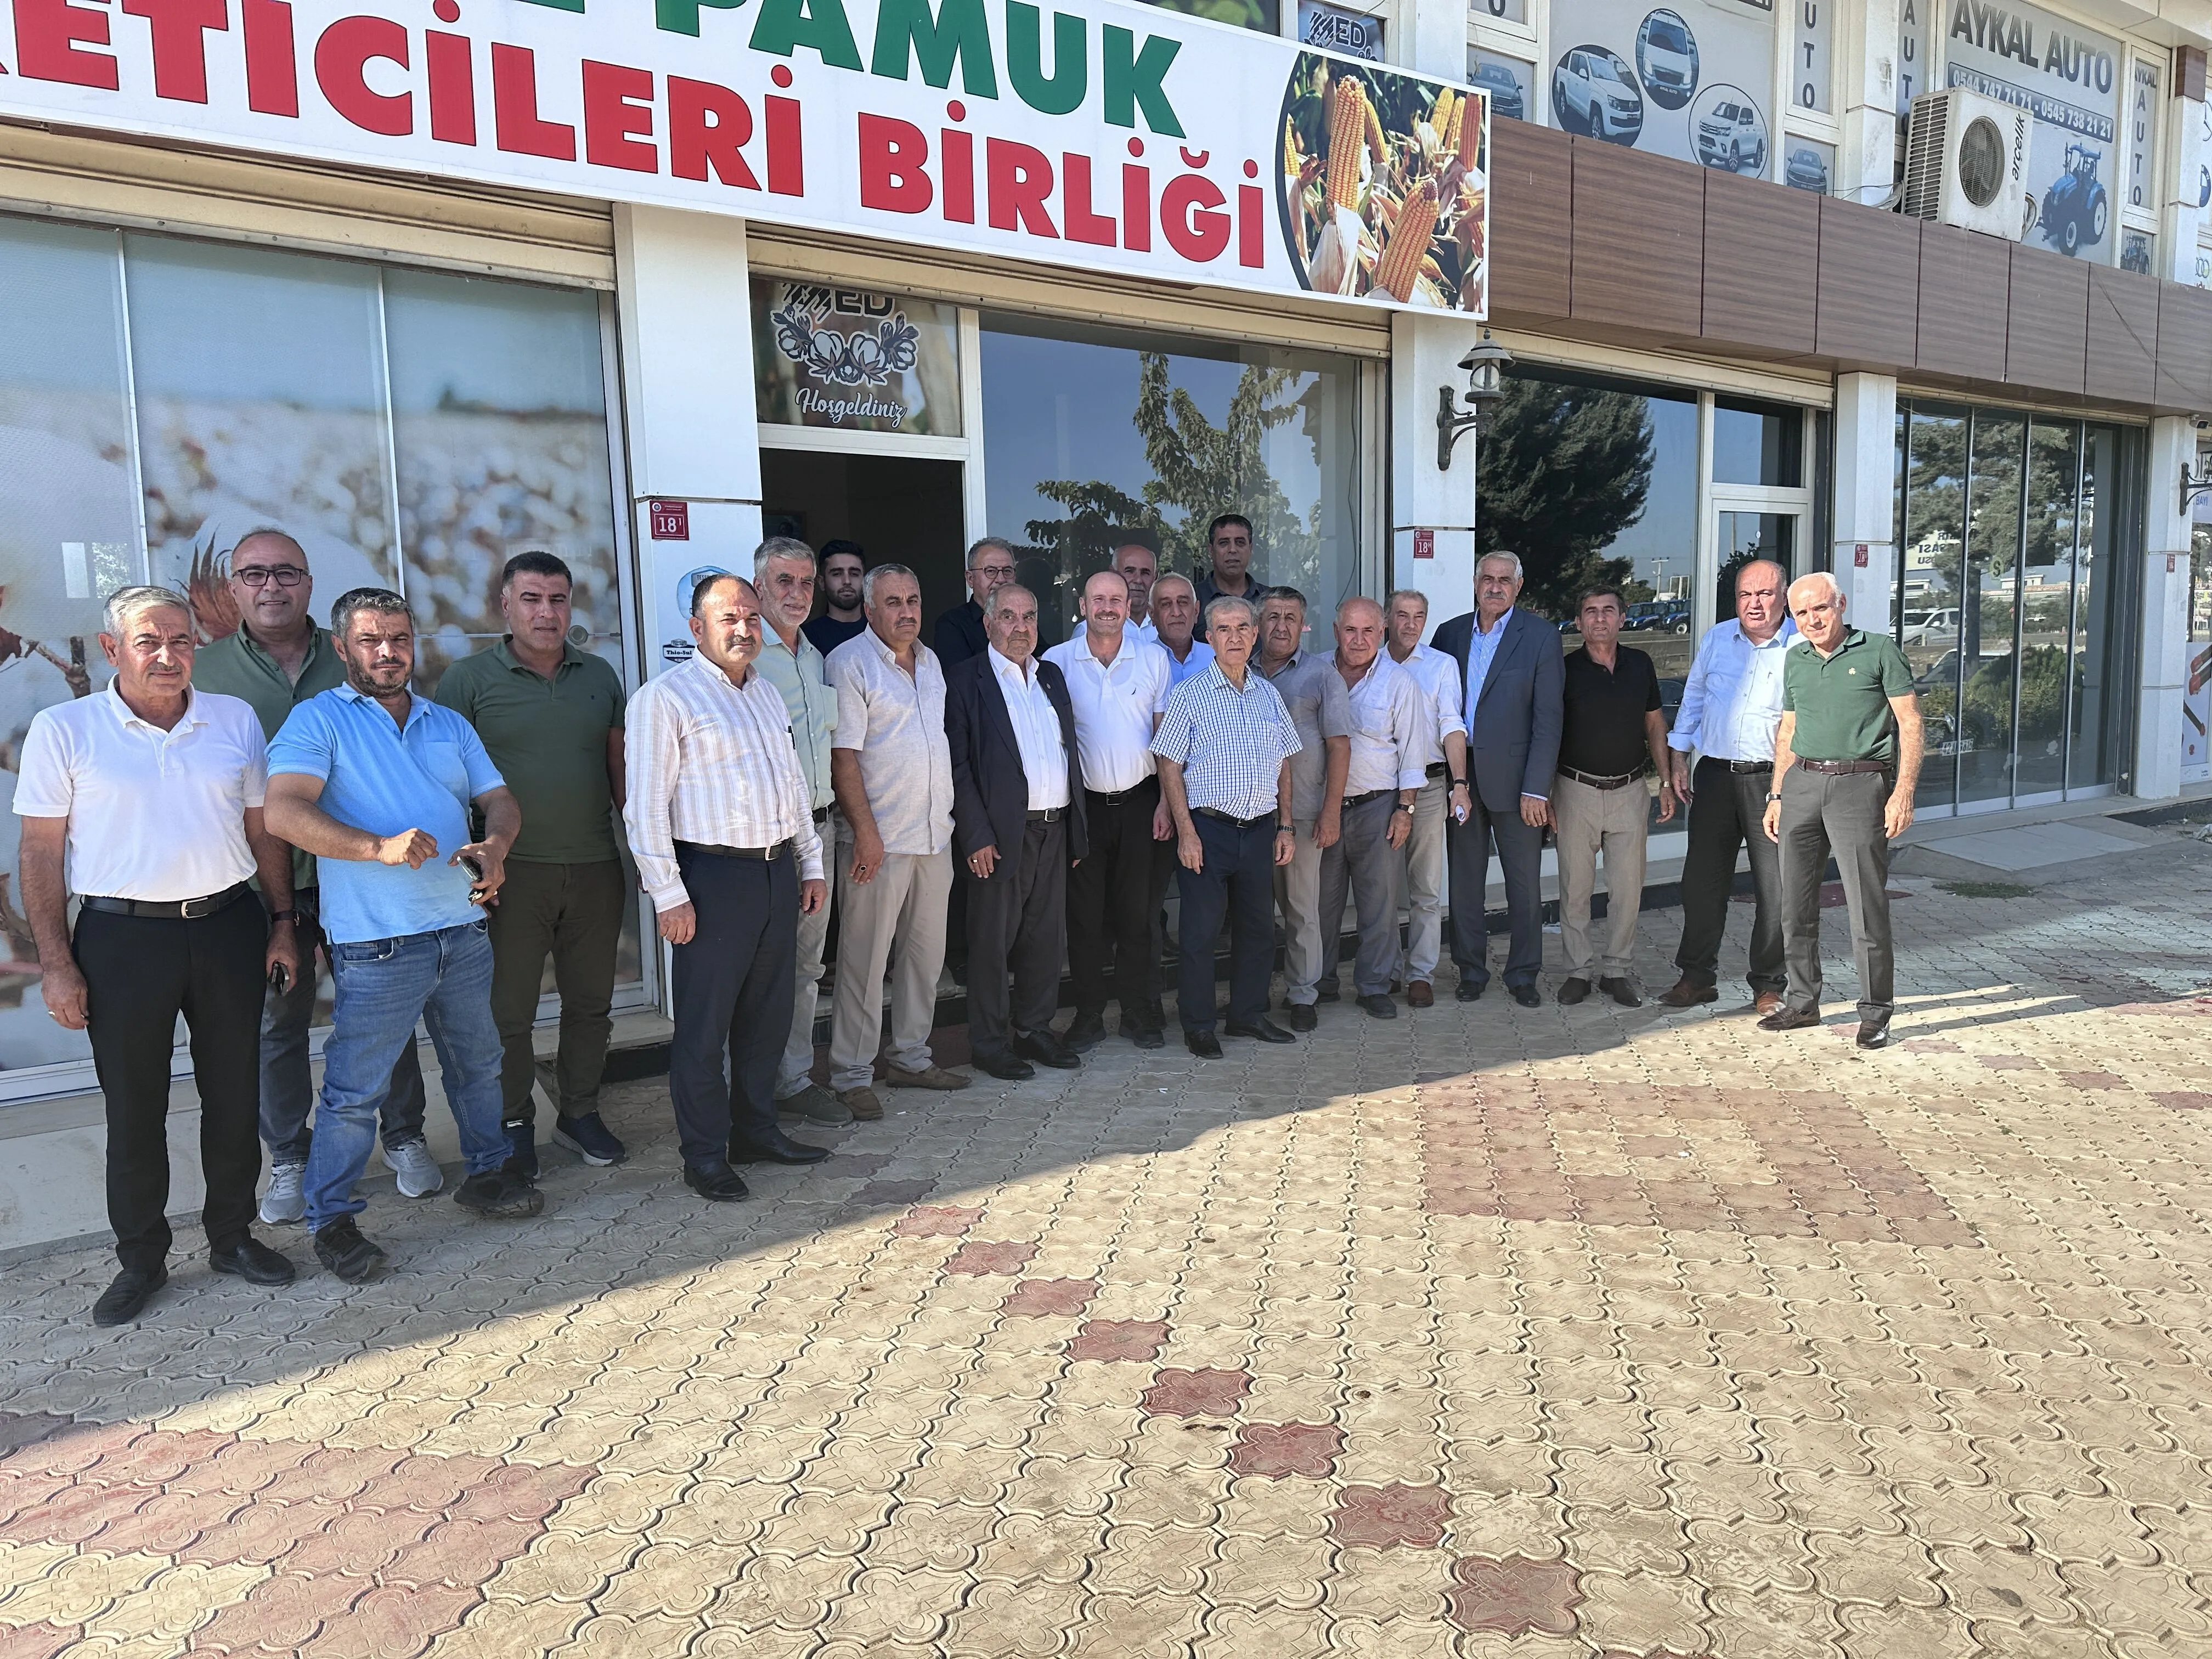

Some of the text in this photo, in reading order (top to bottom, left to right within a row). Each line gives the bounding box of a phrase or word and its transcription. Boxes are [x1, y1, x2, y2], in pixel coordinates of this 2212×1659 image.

[1950, 0, 2112, 94] AYKAL AUTO
[1953, 70, 1979, 92] 0544
[1983, 80, 2002, 100] 747
[2005, 87, 2017, 105] 71
[2020, 92, 2032, 110] 71
[2041, 100, 2064, 122] 0545
[2067, 109, 2084, 129] 738
[2087, 116, 2098, 134] 21
[2100, 121, 2111, 138] 21
[2012, 113, 2025, 181] arçelik
[858, 100, 1264, 269] BİRLİĞİ
[795, 388, 909, 428] Hoşgeldiniz
[659, 517, 677, 533] 18
[1418, 541, 1428, 553] 18
